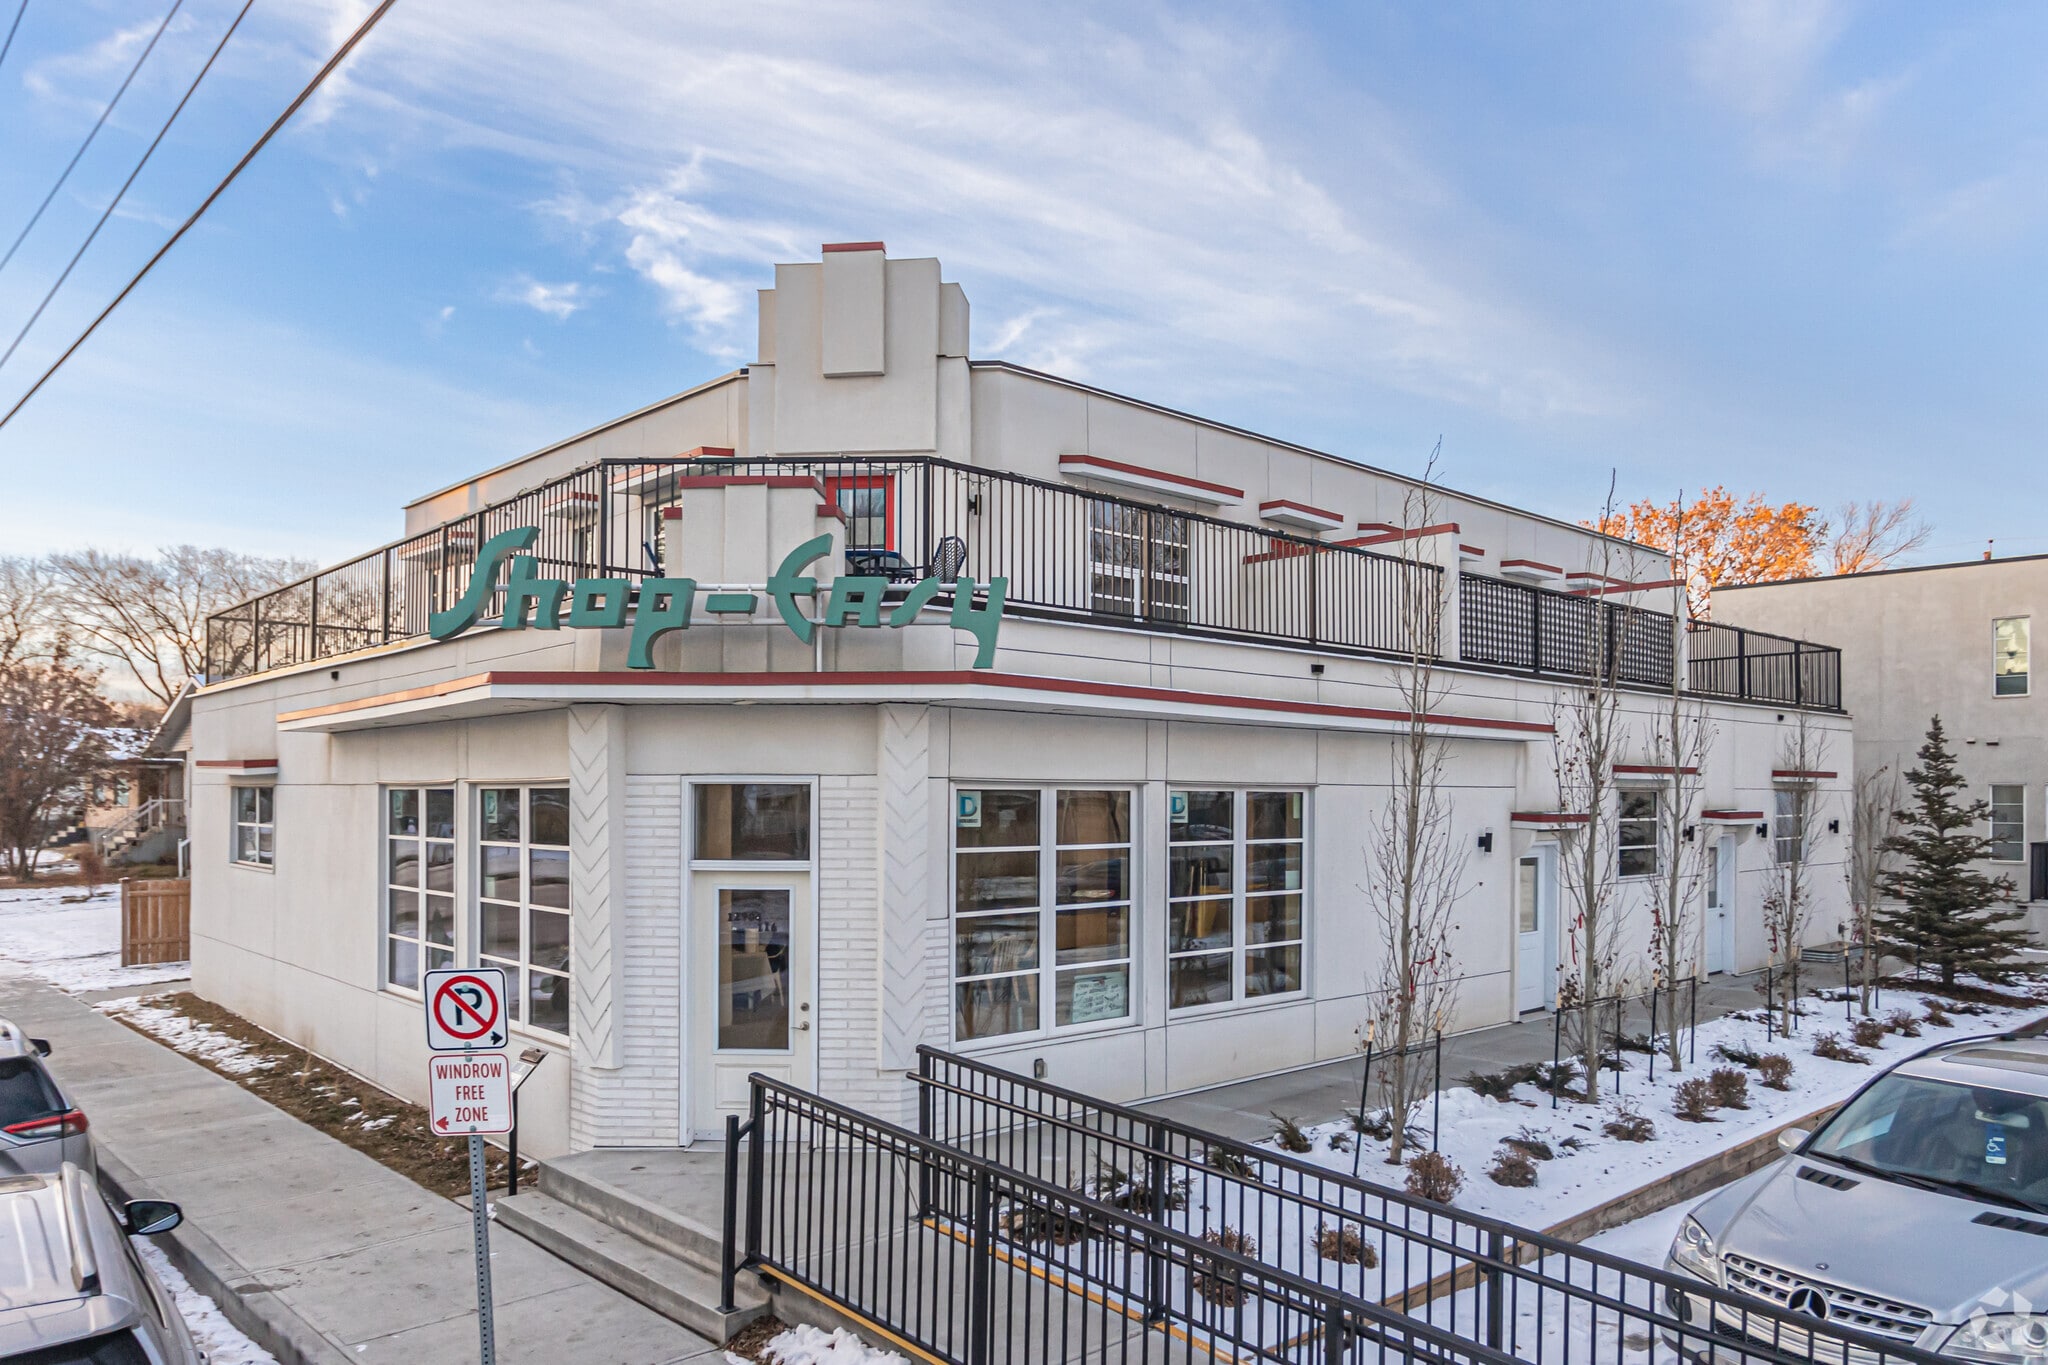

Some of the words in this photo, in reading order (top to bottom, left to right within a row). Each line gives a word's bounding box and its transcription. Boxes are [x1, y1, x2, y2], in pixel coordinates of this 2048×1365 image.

[436, 1062, 502, 1080] WINDROW
[455, 1085, 485, 1101] FREE
[454, 1106, 489, 1123] ZONE
